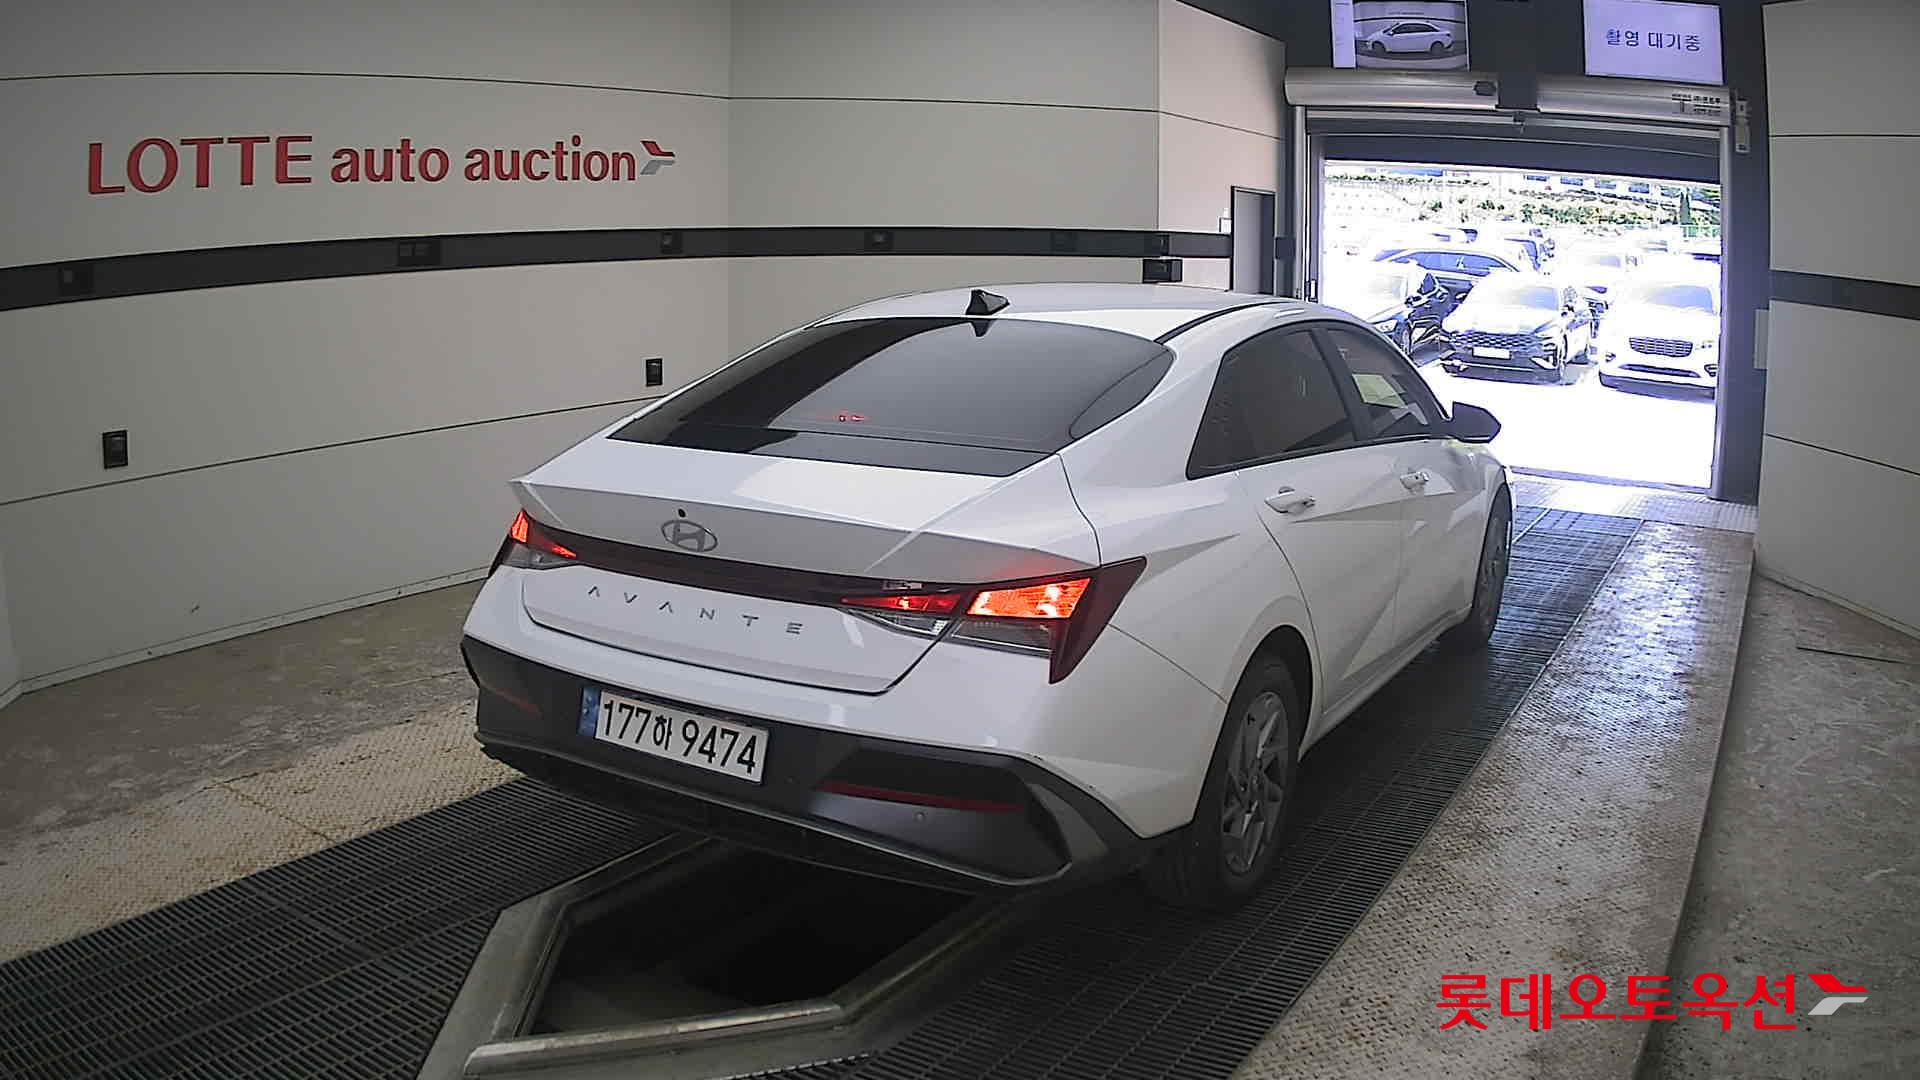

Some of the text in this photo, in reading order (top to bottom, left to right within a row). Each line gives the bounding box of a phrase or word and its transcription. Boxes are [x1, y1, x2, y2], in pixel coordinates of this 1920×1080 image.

[1606, 28, 1701, 52] 촬영 대기중
[87, 134, 638, 195] LOTTE auto auction
[587, 585, 803, 636] AVANTE
[603, 699, 758, 774] 177하 9474
